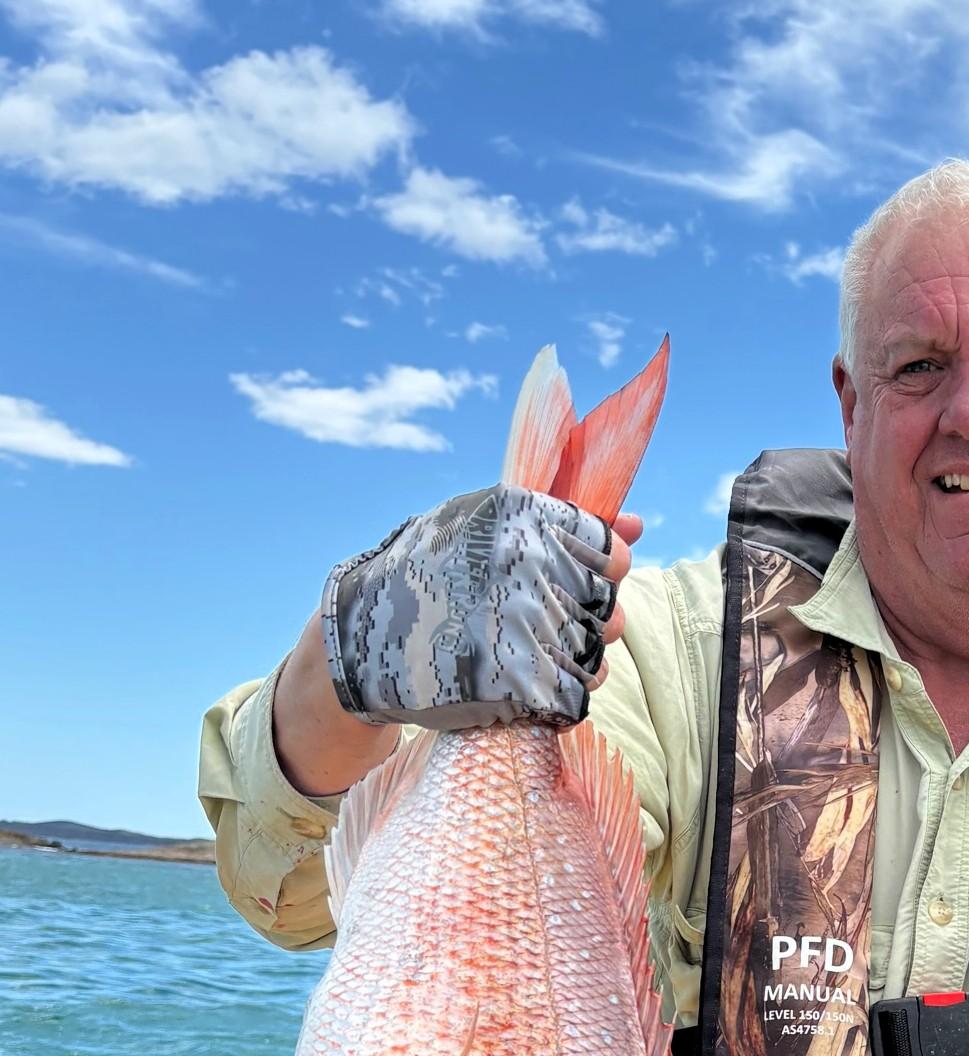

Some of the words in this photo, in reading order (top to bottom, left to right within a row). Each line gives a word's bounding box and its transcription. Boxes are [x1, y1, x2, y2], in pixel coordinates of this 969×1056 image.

[771, 935, 854, 973] PFD
[764, 983, 856, 1006] MANUAL
[764, 1009, 796, 1021] LEVEL
[799, 1010, 854, 1024] 150/150N
[781, 1024, 834, 1036] AS4758.1
